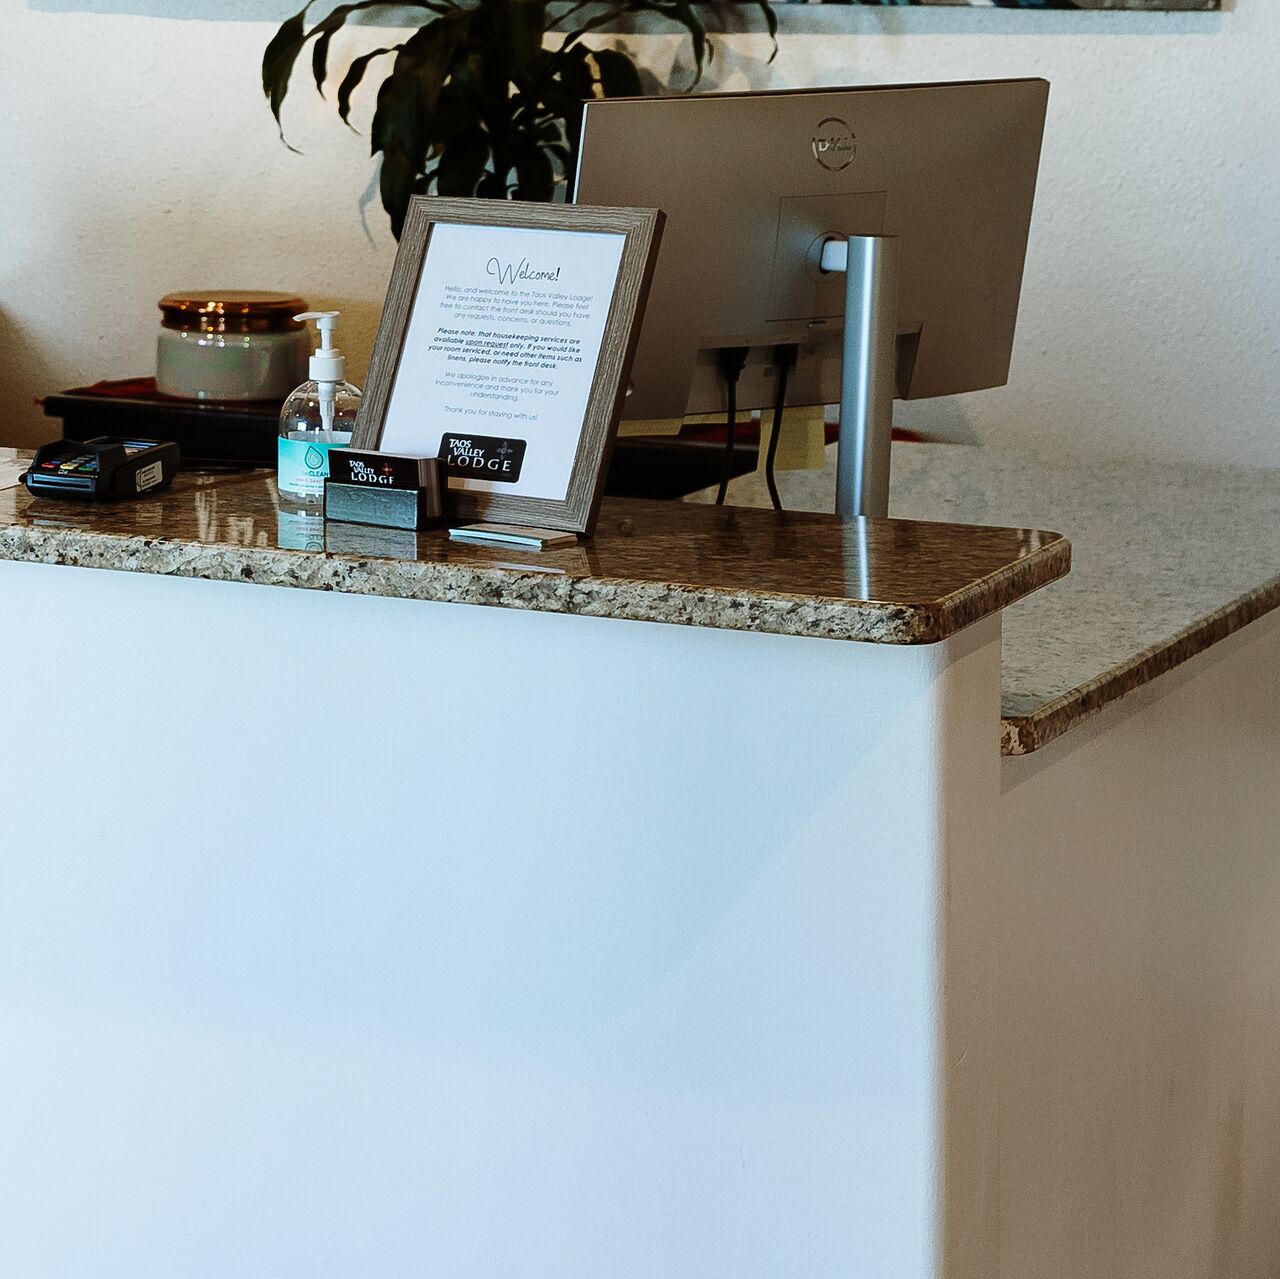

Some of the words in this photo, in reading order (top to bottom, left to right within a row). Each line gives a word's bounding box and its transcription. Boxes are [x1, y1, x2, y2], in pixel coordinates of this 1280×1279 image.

[486, 258, 560, 284] Welcome!
[492, 332, 539, 342] housekeeping
[436, 380, 483, 389] inconvenience
[489, 410, 512, 419] staying
[449, 439, 472, 448] TAOS
[453, 446, 484, 457] VALLEY
[448, 455, 511, 472] LODGE
